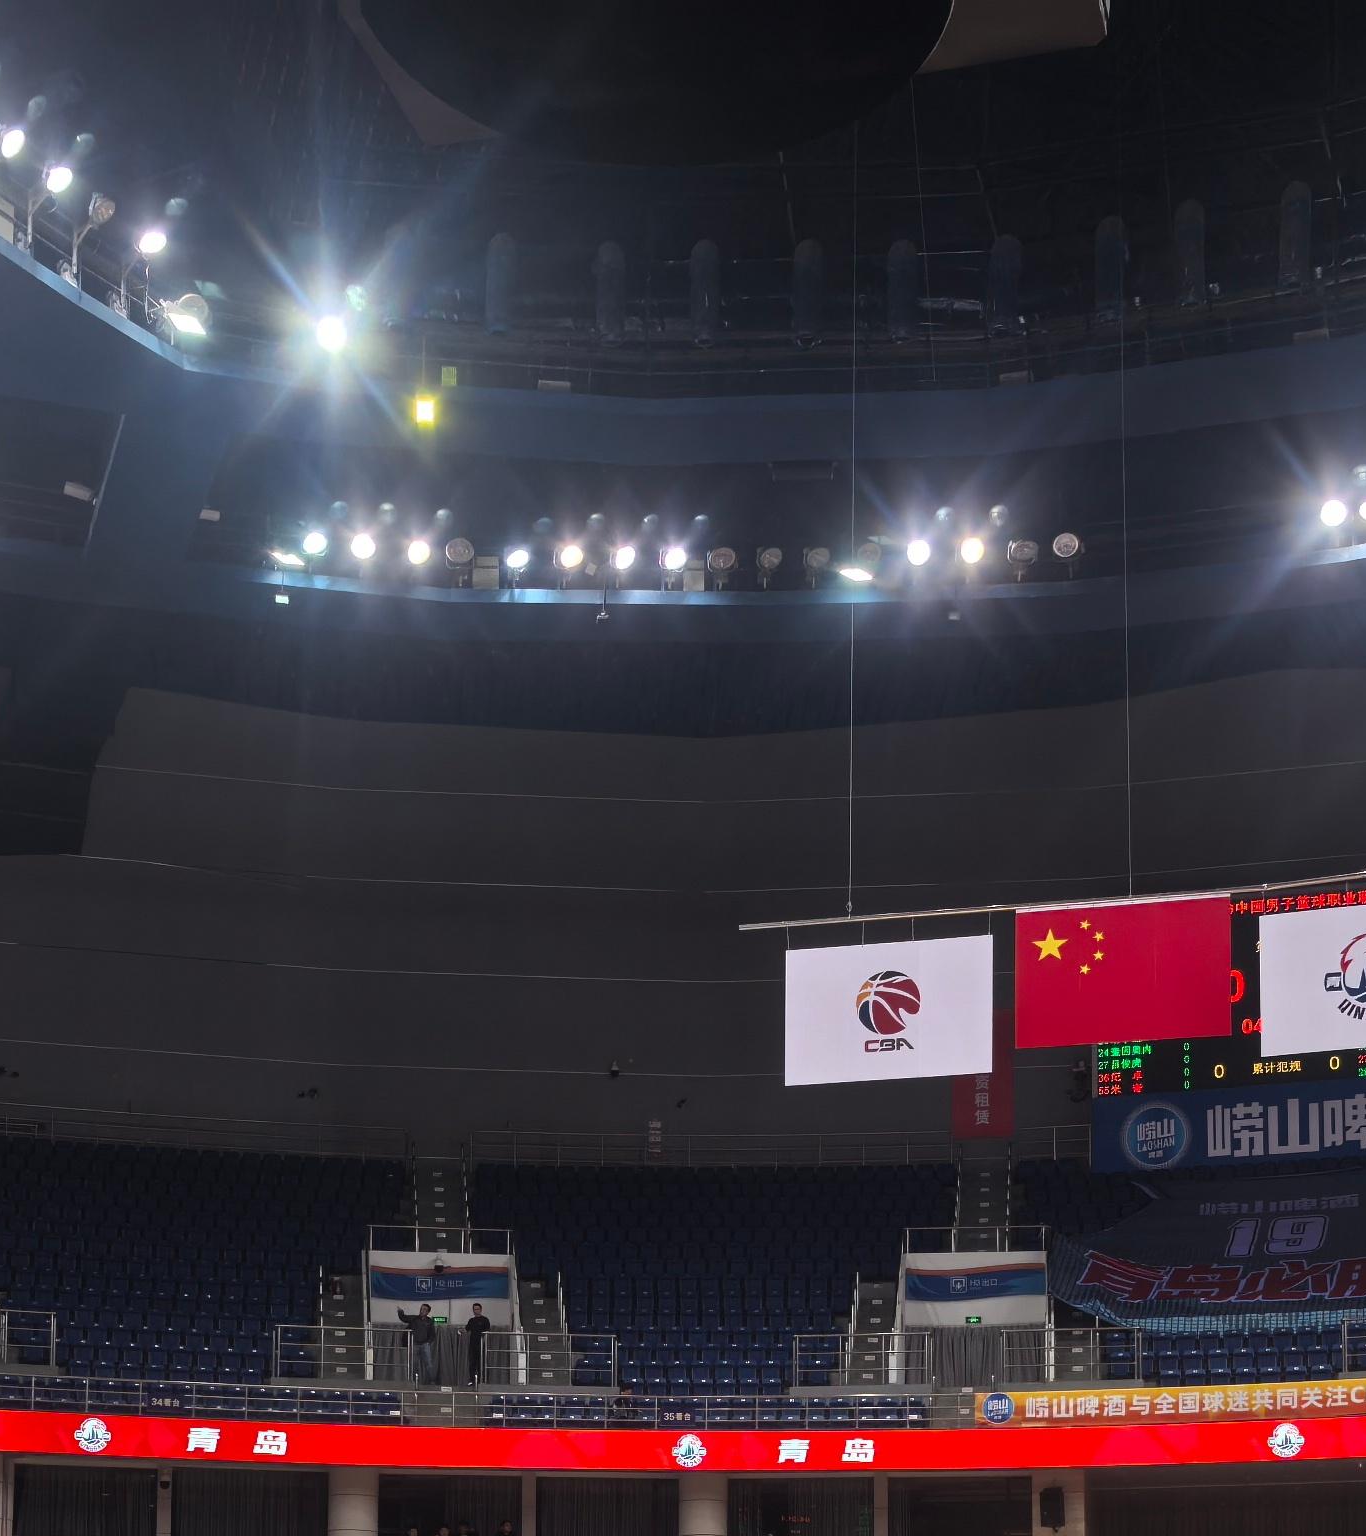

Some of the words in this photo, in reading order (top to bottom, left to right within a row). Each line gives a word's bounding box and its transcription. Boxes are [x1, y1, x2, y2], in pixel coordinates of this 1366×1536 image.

[864, 1038, 915, 1053] CBA
[1252, 1060, 1302, 1075] 累计犯规
[1137, 1118, 1176, 1141] 崂山
[1137, 1136, 1175, 1153] LAOSHAN
[1225, 1215, 1330, 1258] 19
[663, 1412, 691, 1421] 35看台
[187, 1427, 288, 1455] 青岛
[778, 1438, 875, 1463] 青岛
